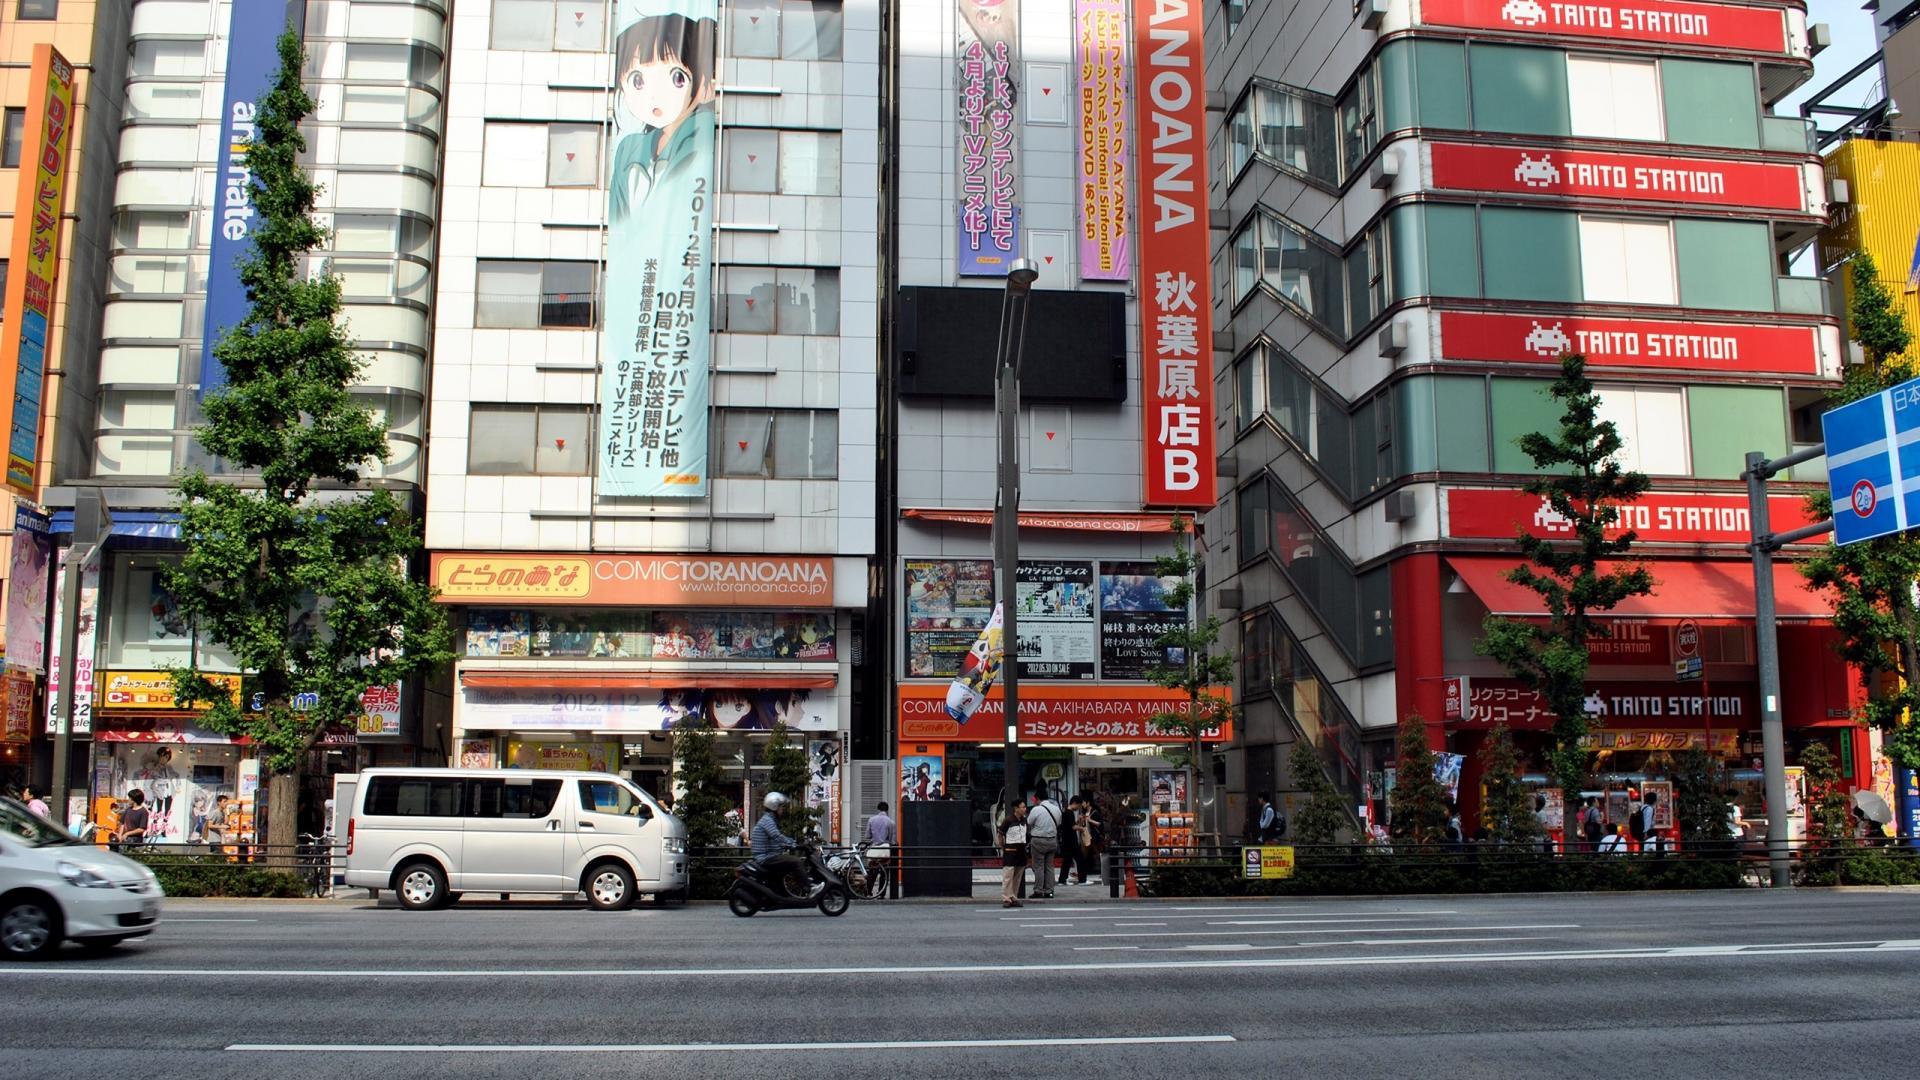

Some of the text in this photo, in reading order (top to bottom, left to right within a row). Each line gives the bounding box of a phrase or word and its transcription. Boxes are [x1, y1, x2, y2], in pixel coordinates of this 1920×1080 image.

[1551, 2, 1709, 36] TAITO STATION
[1083, 88, 1095, 176] BD&DVD
[223, 101, 256, 241] animate
[1564, 162, 1725, 194] TAITO STATION
[1113, 161, 1125, 238] AYANA
[1575, 330, 1738, 360] TAITO STATION
[1155, 270, 1201, 491] 秋葉原店B
[17, 512, 49, 534] animate
[1658, 507, 1751, 532] STATION
[449, 564, 580, 587] とらのあな
[595, 560, 828, 583] COMICTORANOANA
[679, 581, 828, 596] www.toranoana.co.jp/
[1585, 643, 1651, 653] TAITO STATION
[1053, 702, 1134, 714] AKIHABARA
[1138, 702, 1175, 714] MAIN
[1612, 697, 1742, 716] TAITO STATION
[359, 714, 383, 732] 6.8
[1024, 721, 1140, 736] コミックとらのあな
